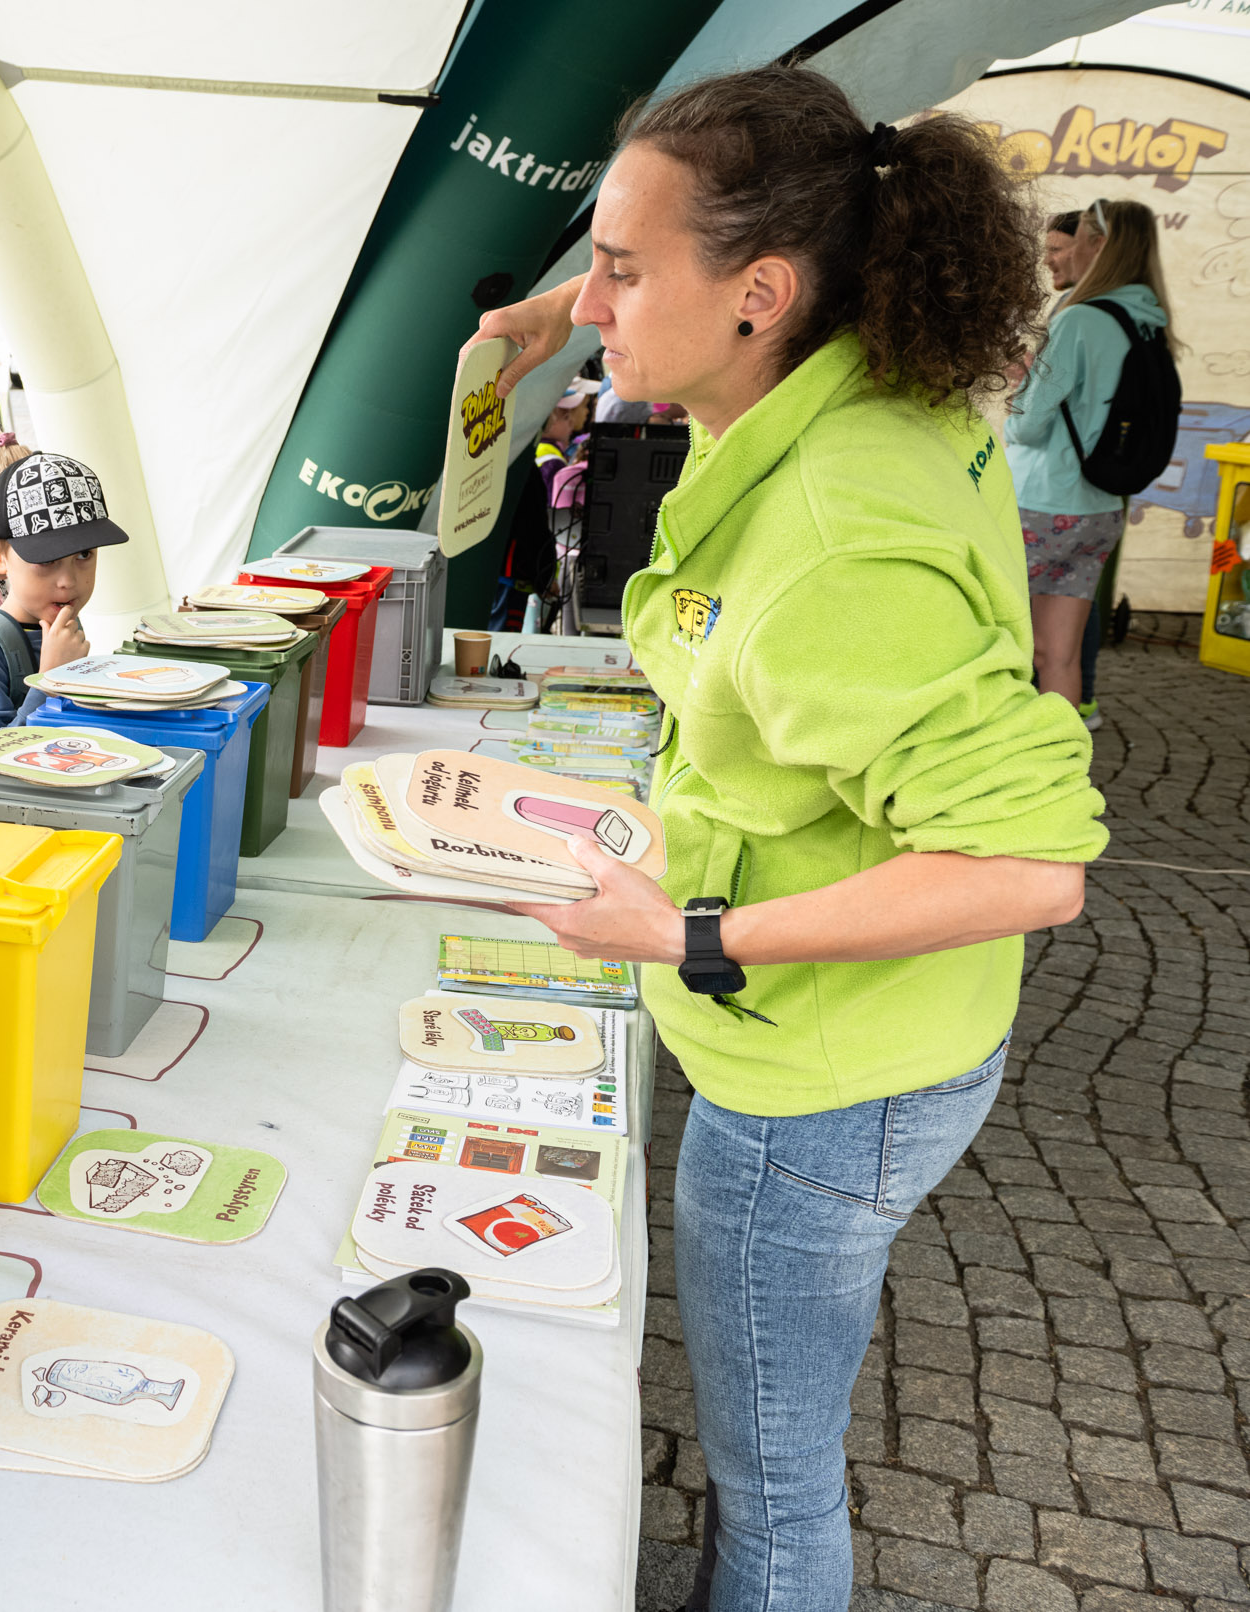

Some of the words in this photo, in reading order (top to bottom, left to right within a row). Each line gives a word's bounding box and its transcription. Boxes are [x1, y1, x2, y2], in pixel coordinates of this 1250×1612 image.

[967, 435, 995, 493] KOM
[431, 761, 451, 774] od
[453, 770, 481, 810] Kelímek
[422, 1010, 442, 1029] Staré
[421, 1030, 445, 1047] léky
[216, 1168, 261, 1223] Polystyren
[365, 1181, 397, 1223] polévky
[407, 1184, 437, 1215] Sáček
[405, 1216, 425, 1231] od
